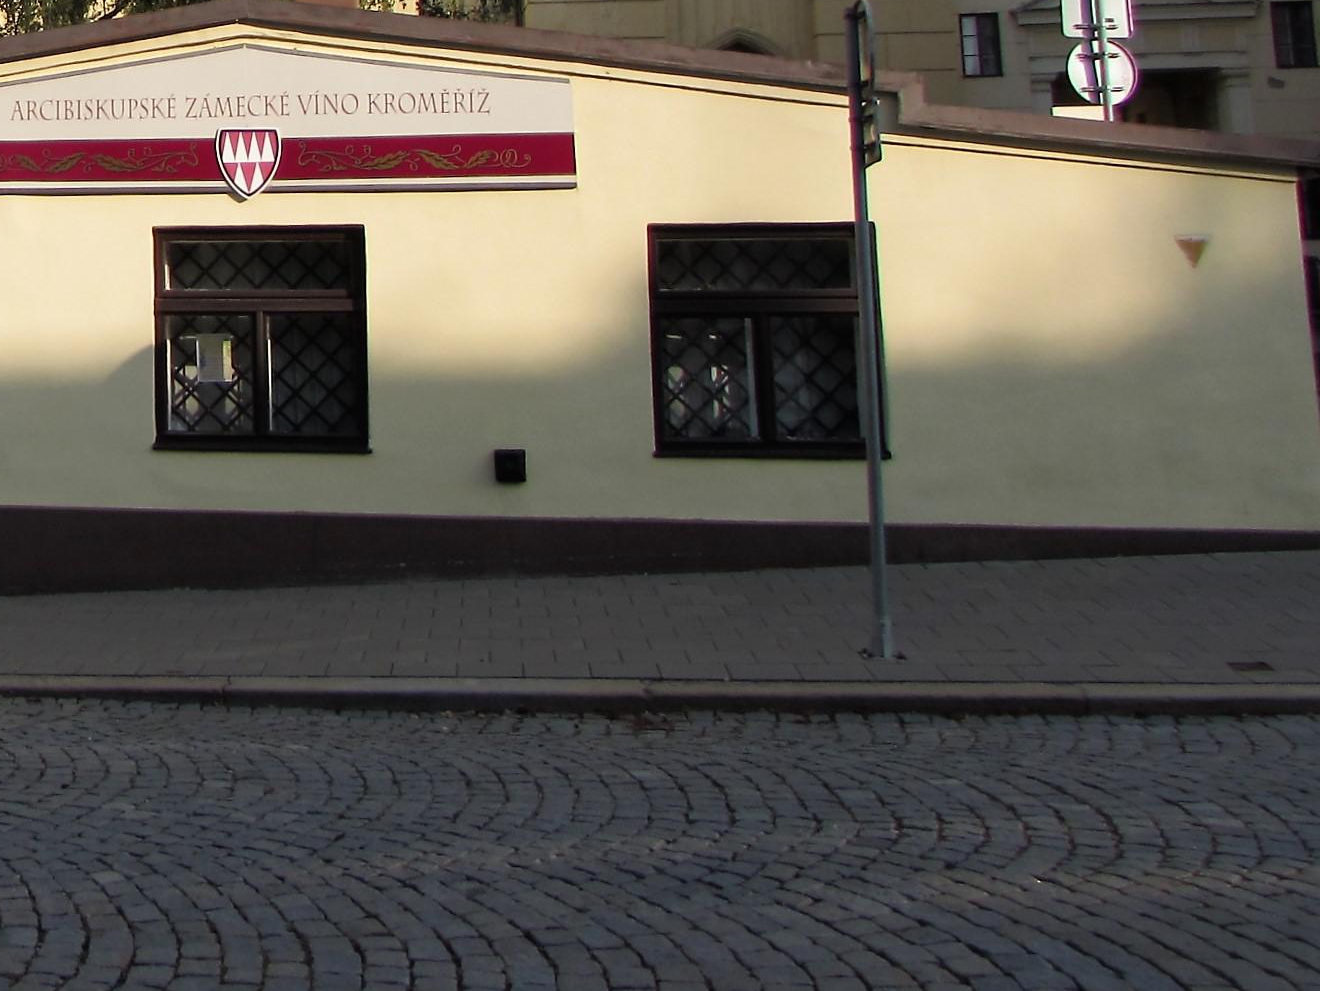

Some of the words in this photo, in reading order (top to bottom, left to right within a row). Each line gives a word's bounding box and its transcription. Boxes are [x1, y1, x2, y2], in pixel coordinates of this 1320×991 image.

[10, 93, 177, 121] ARCIBISKUPSKÉ
[185, 91, 290, 118] ZÁMECKÉ
[297, 90, 359, 115] VÍNO
[367, 88, 491, 115] KROMĚŘÍŽ
